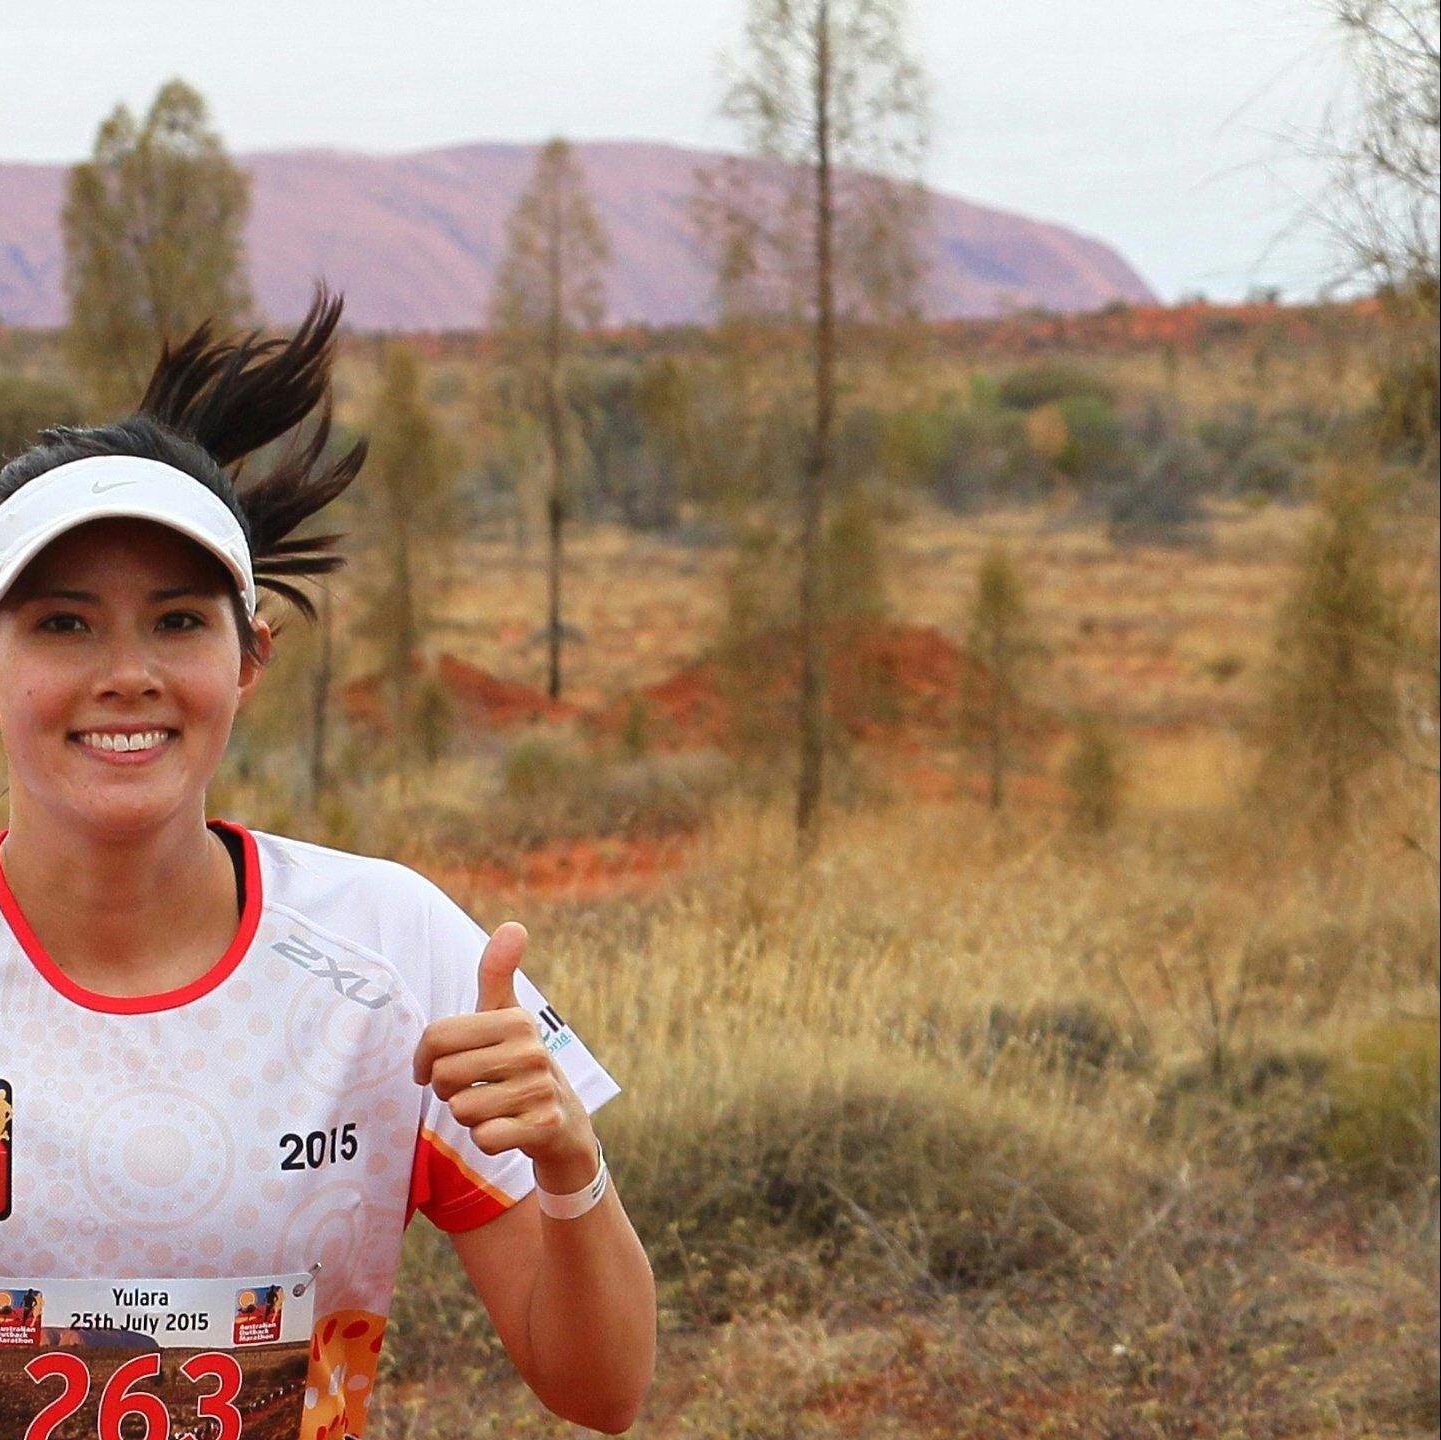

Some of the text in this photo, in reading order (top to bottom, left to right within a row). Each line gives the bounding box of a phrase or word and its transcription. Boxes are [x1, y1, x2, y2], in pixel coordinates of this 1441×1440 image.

[279, 1123, 358, 1171] 2015
[112, 1288, 169, 1307] Yulara
[71, 1312, 209, 1335] 25th July 2015
[239, 1321, 277, 1330] Australian
[239, 1328, 269, 1336] Outback
[239, 1334, 275, 1342] Marathon
